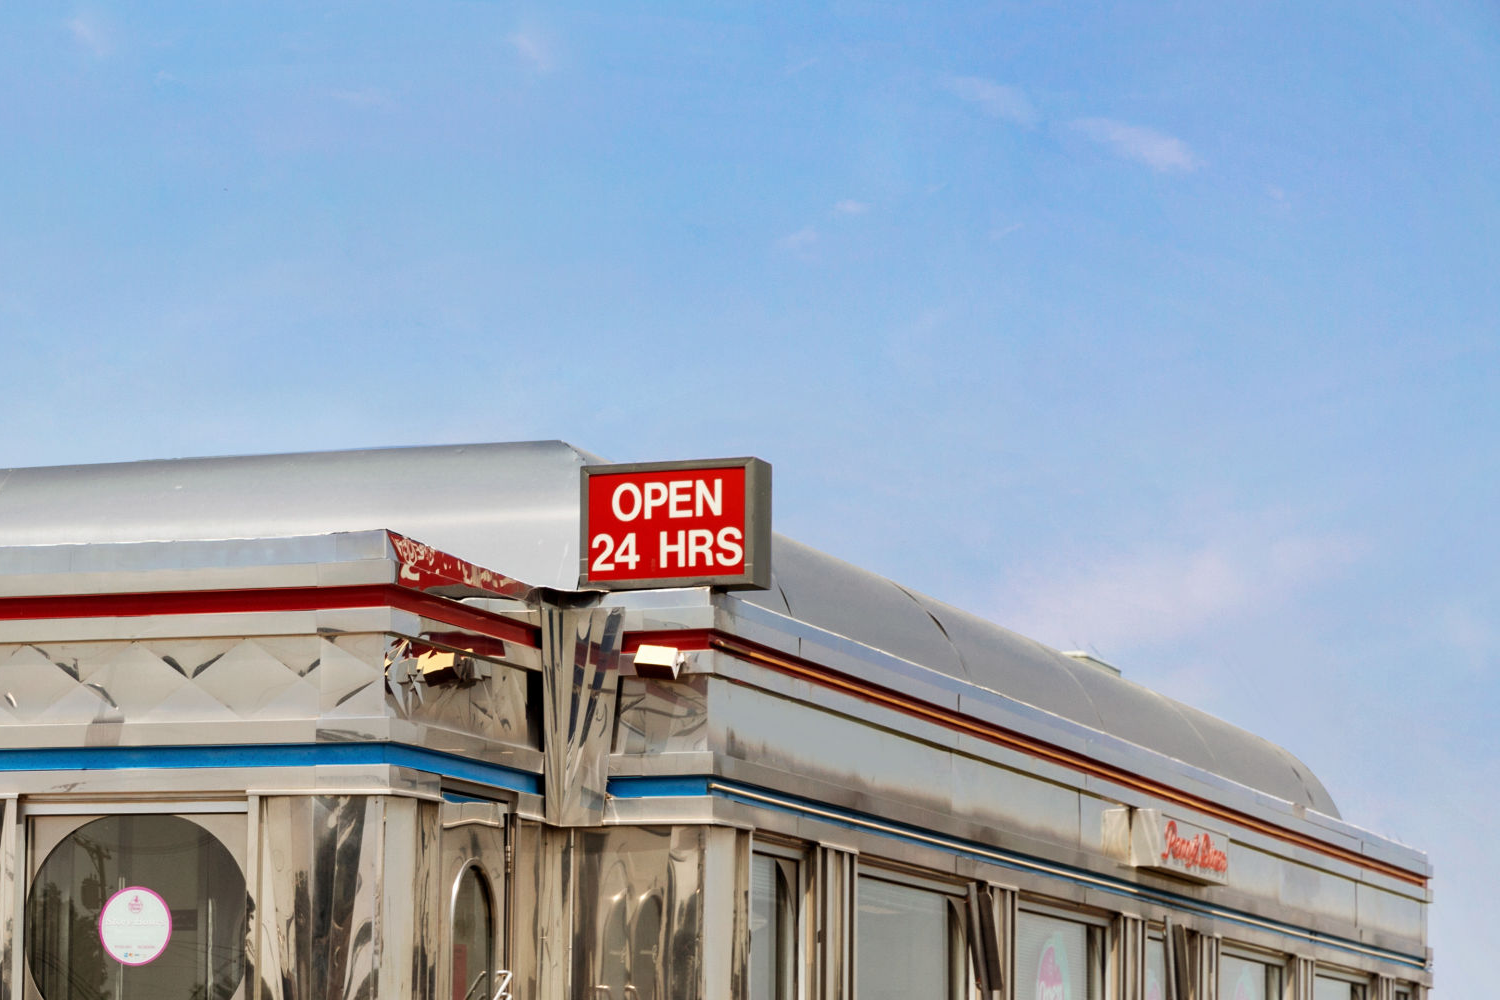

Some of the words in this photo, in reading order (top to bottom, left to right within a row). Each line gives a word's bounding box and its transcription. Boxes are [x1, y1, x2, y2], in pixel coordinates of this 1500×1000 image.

[611, 479, 723, 522] OPEN
[591, 533, 641, 572] 24
[659, 527, 743, 569] HRS
